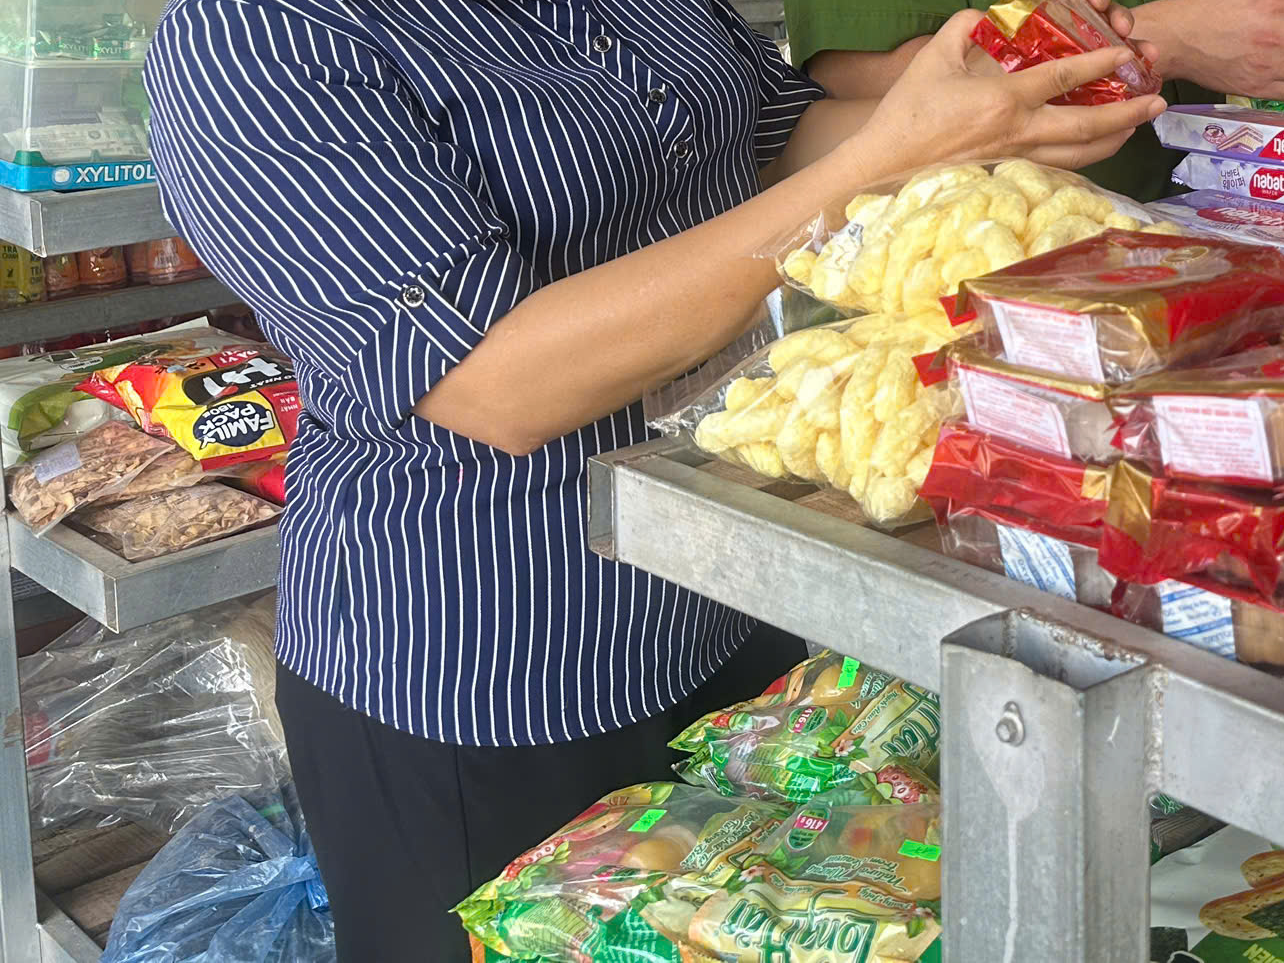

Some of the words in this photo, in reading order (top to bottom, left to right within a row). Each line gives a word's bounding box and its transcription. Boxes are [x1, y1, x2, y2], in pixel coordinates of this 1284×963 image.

[76, 164, 156, 184] XYLITOL
[198, 403, 257, 435] PACK
[200, 408, 276, 450] FAMILY
